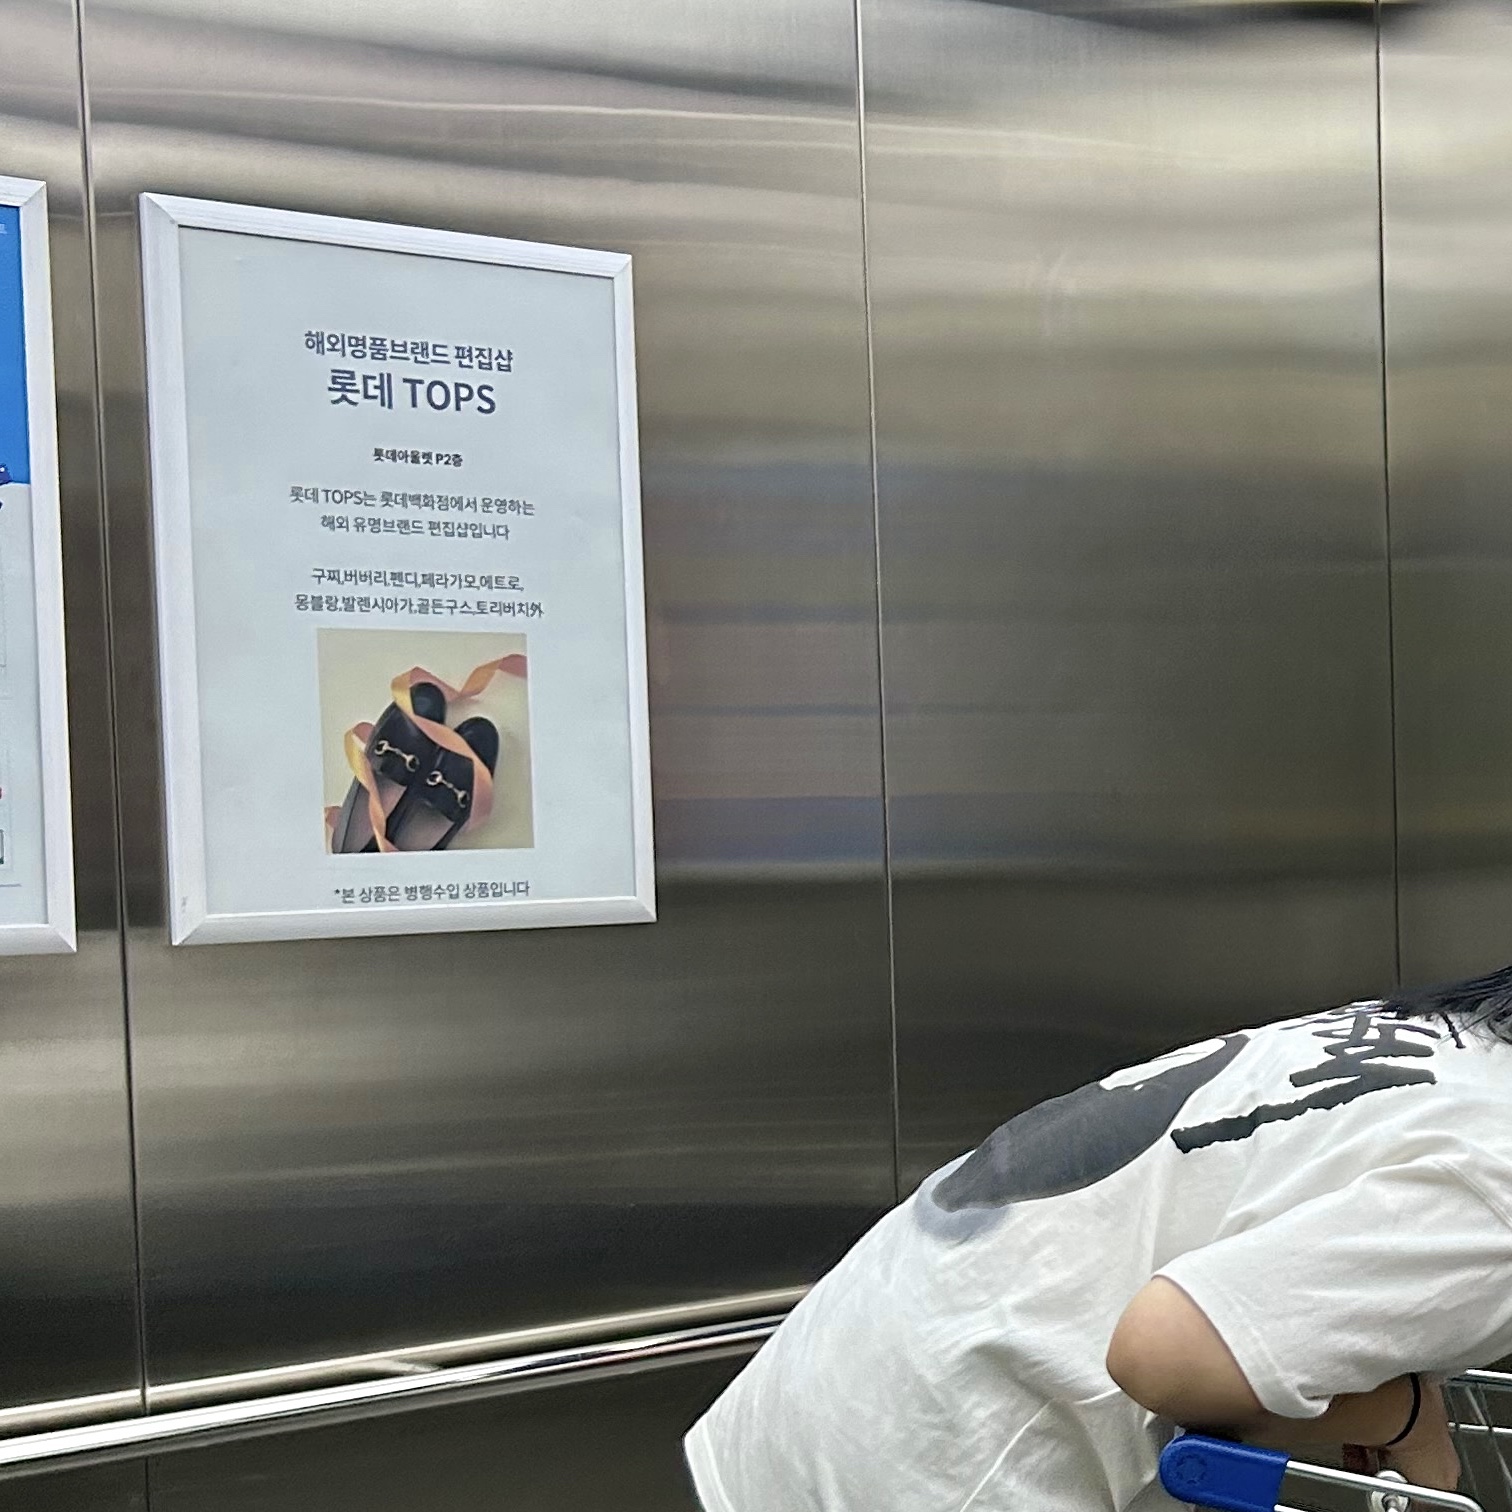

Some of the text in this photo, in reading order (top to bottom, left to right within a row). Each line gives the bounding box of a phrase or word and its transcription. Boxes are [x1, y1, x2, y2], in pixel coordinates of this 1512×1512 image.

[304, 330, 514, 373] 해외명품브랜드 편집샵
[327, 368, 497, 415] 롯데 TOPS
[373, 448, 464, 468] 롯데아울렛 P2층
[290, 486, 535, 516] 롯데 TOPS는 롯데백화점에서 운영하는
[321, 514, 510, 540] 해외 유명브랜드 편집샵입니다
[358, 885, 400, 903] 상품은
[404, 883, 460, 901] 병행수입
[463, 880, 531, 899] 상품입니다
